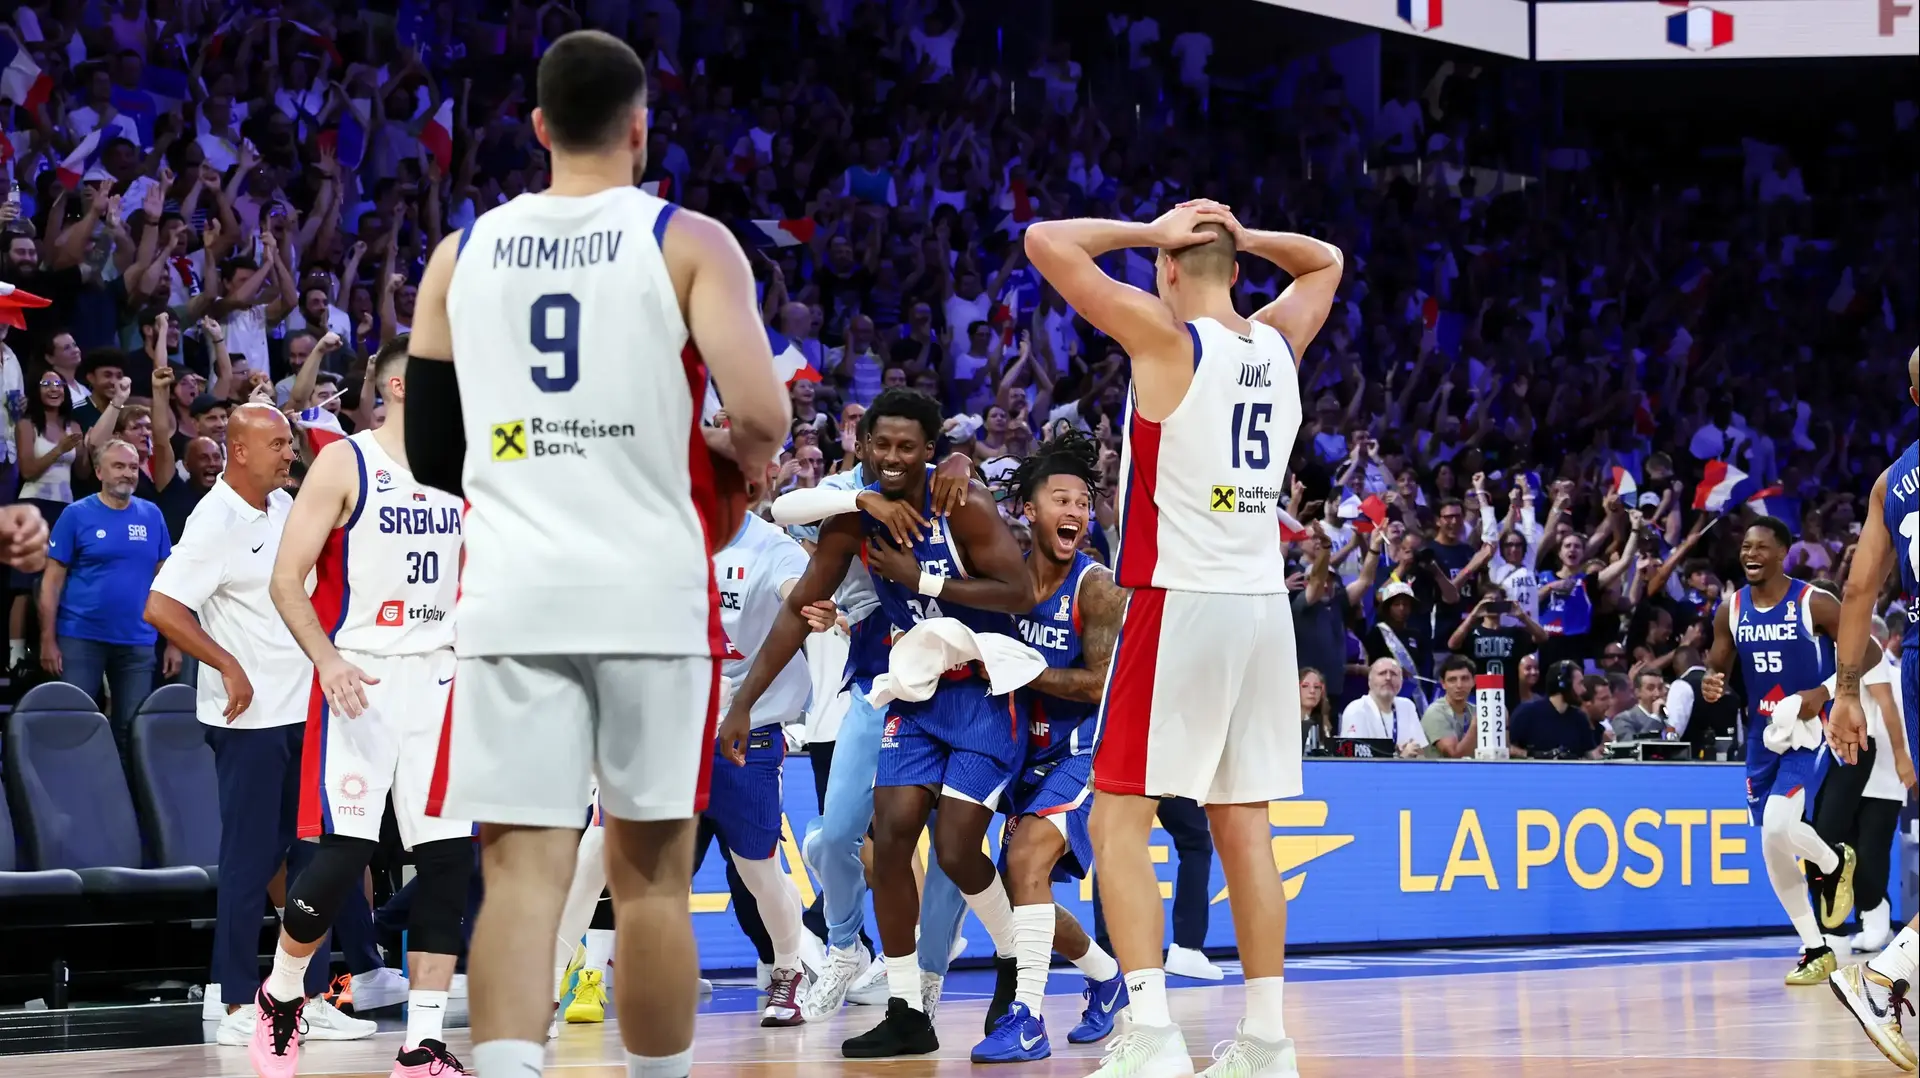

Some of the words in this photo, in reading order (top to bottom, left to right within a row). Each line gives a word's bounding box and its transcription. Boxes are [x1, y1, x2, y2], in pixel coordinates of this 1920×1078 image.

[493, 230, 622, 269] MOMIROV
[530, 293, 580, 393] 9
[532, 417, 635, 438] Raiffeisen
[1231, 402, 1273, 469] 15
[534, 440, 587, 459] Bank
[1238, 501, 1266, 514] Bank
[128, 524, 147, 537] SRB
[379, 506, 461, 535] SRBIJA
[407, 551, 438, 584] 30
[408, 604, 446, 623] triglav
[907, 598, 943, 624] 34
[1738, 623, 1797, 643] FRANCE
[1753, 651, 1782, 673] 55
[1481, 691, 1487, 703] 4
[1494, 691, 1501, 703] 4
[1759, 699, 1781, 713] MA
[1481, 705, 1489, 717] 3
[1495, 705, 1502, 717] 3
[1482, 721, 1489, 732] 2
[1496, 721, 1502, 732] 2
[338, 805, 365, 817] mts
[1399, 809, 1499, 892] LA
[1516, 808, 1749, 890] POSTE
